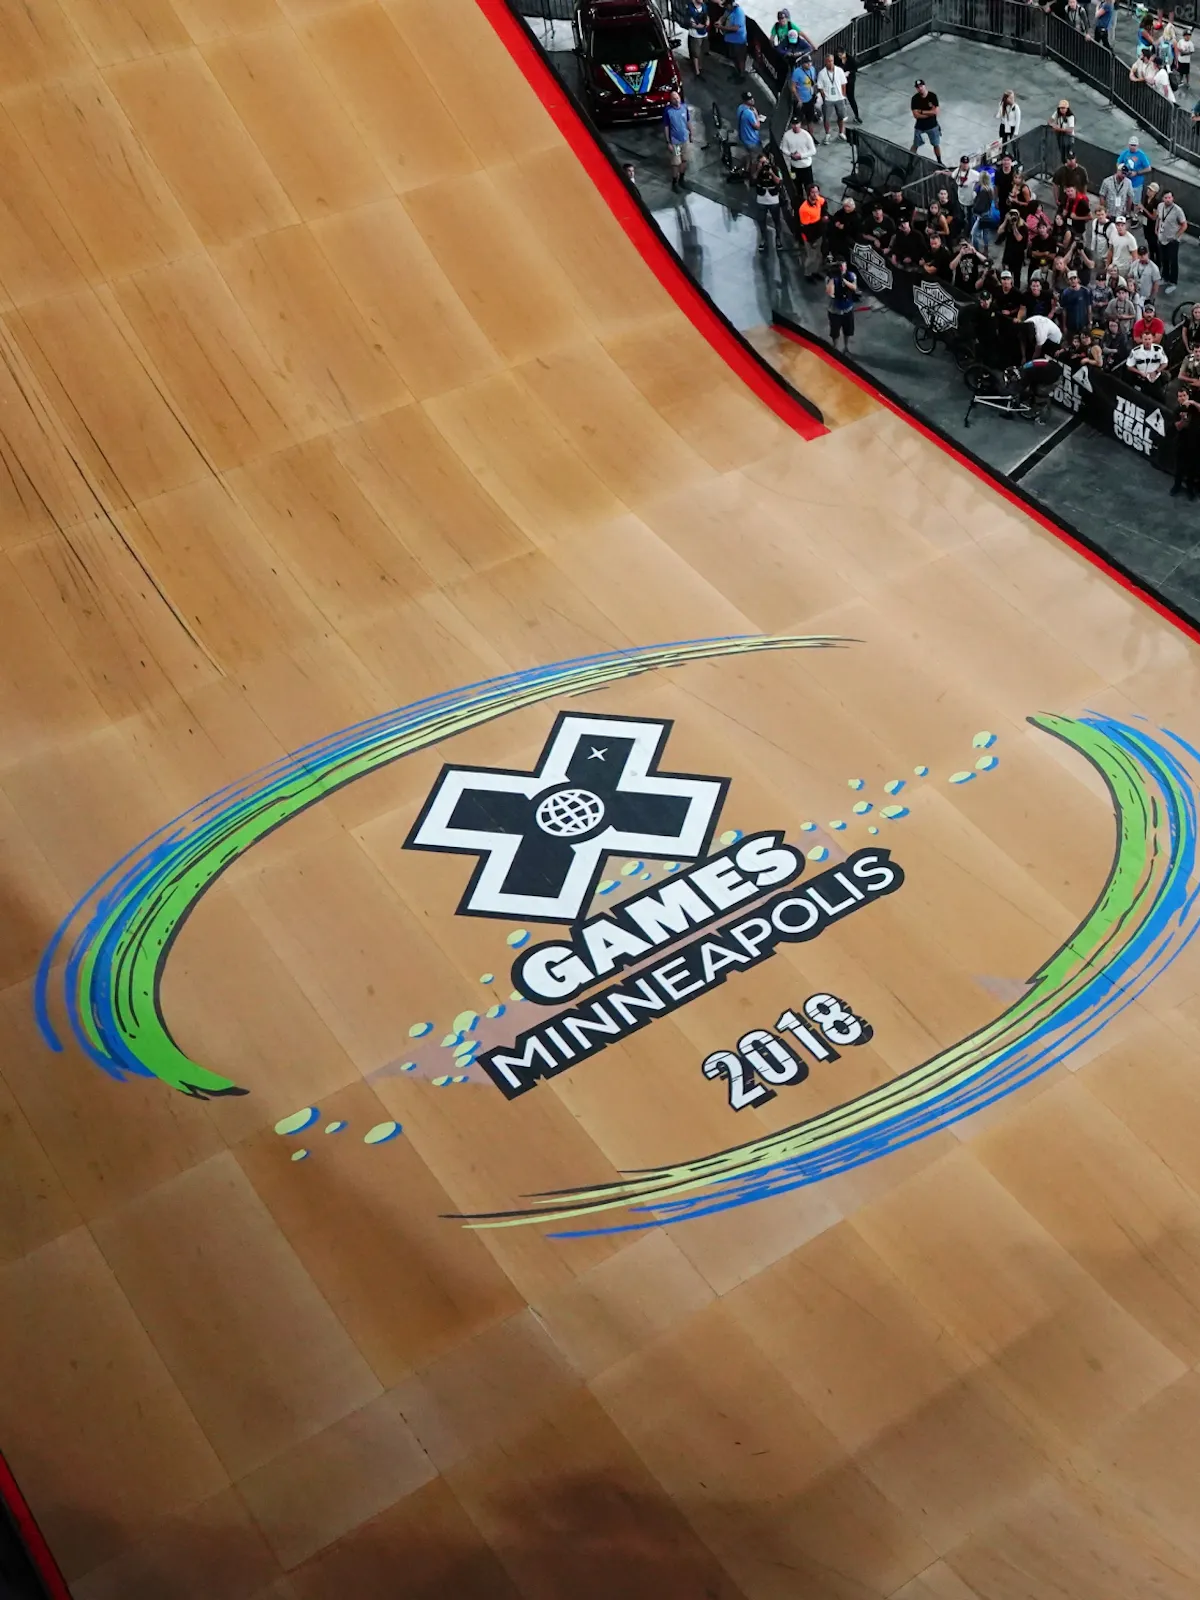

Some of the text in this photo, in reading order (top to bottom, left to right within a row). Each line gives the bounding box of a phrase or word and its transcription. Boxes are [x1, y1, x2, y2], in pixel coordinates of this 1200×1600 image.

[1049, 386, 1082, 412] OST
[1115, 395, 1146, 424] THE
[1113, 409, 1153, 444] REAL
[1113, 423, 1153, 456] COST
[518, 833, 800, 1001] GAMES
[490, 854, 897, 1091] MINNEAPOLIS
[702, 993, 870, 1111] 2018
